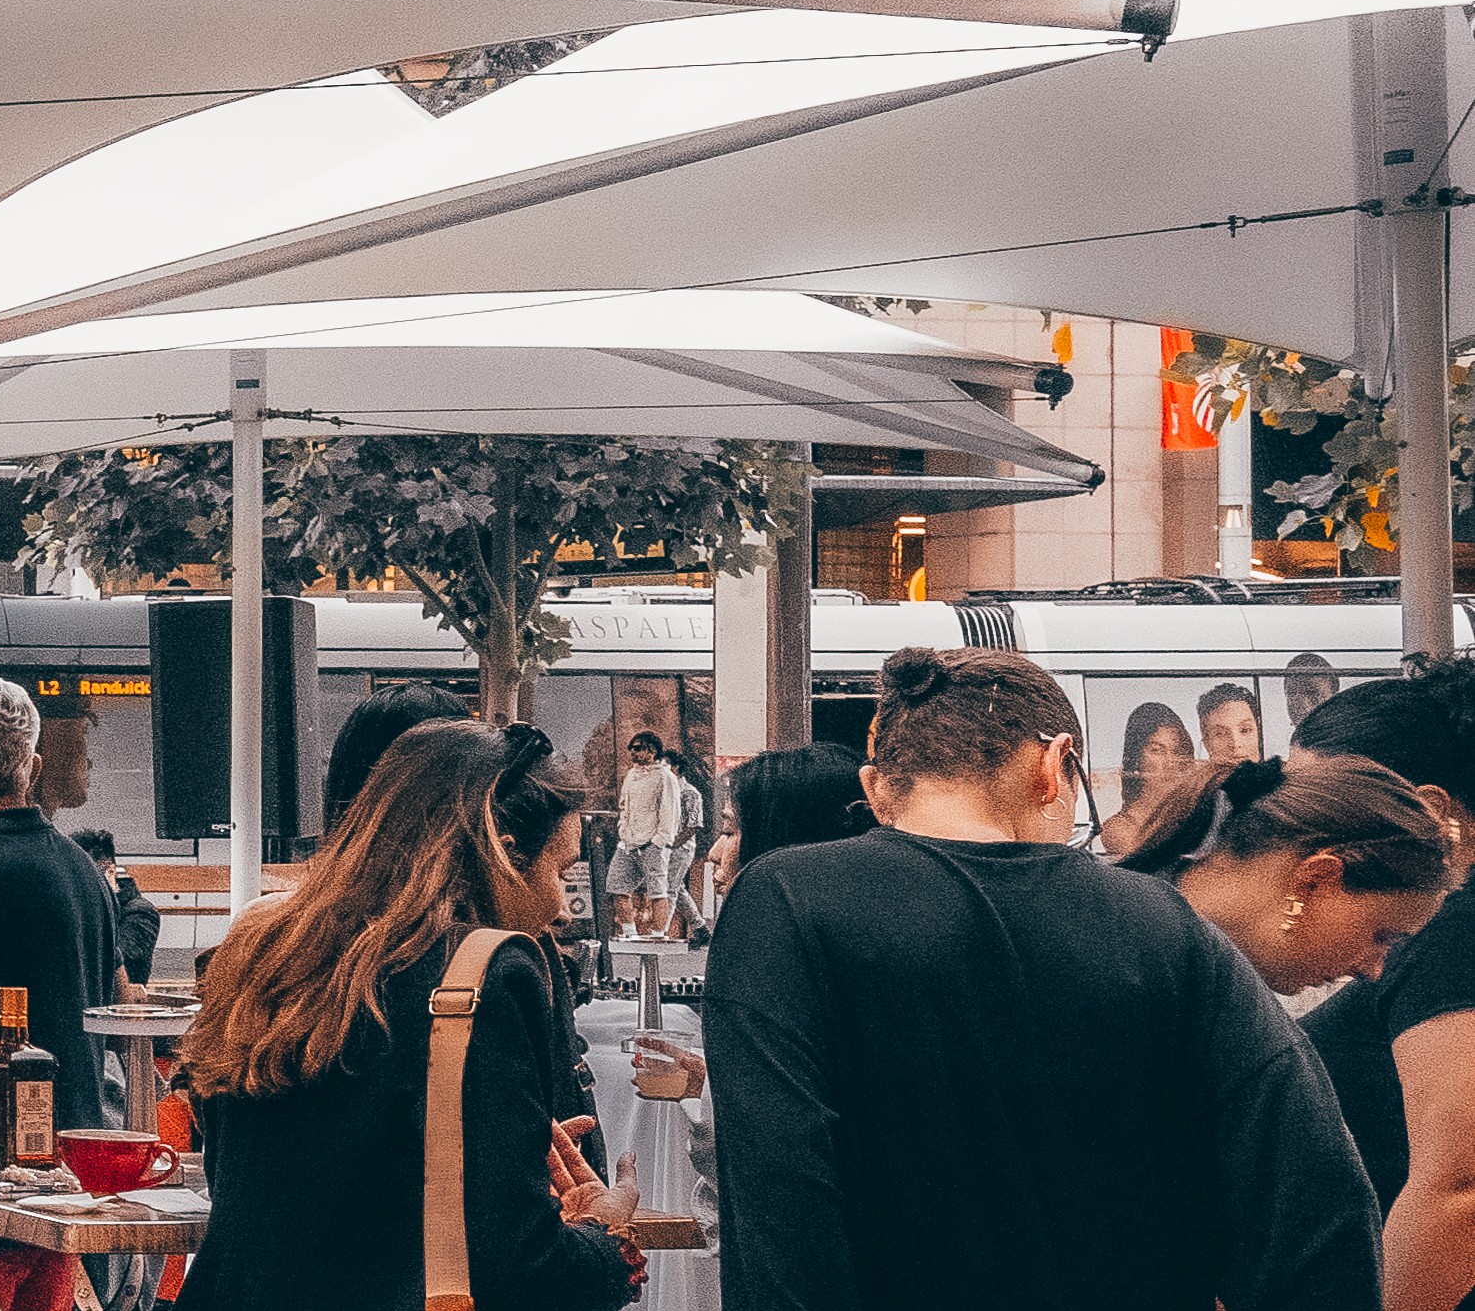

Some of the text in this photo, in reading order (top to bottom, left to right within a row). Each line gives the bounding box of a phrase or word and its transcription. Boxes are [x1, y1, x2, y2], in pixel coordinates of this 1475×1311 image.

[569, 615, 714, 640] ASPALE
[38, 680, 152, 695] L2 Randwick
